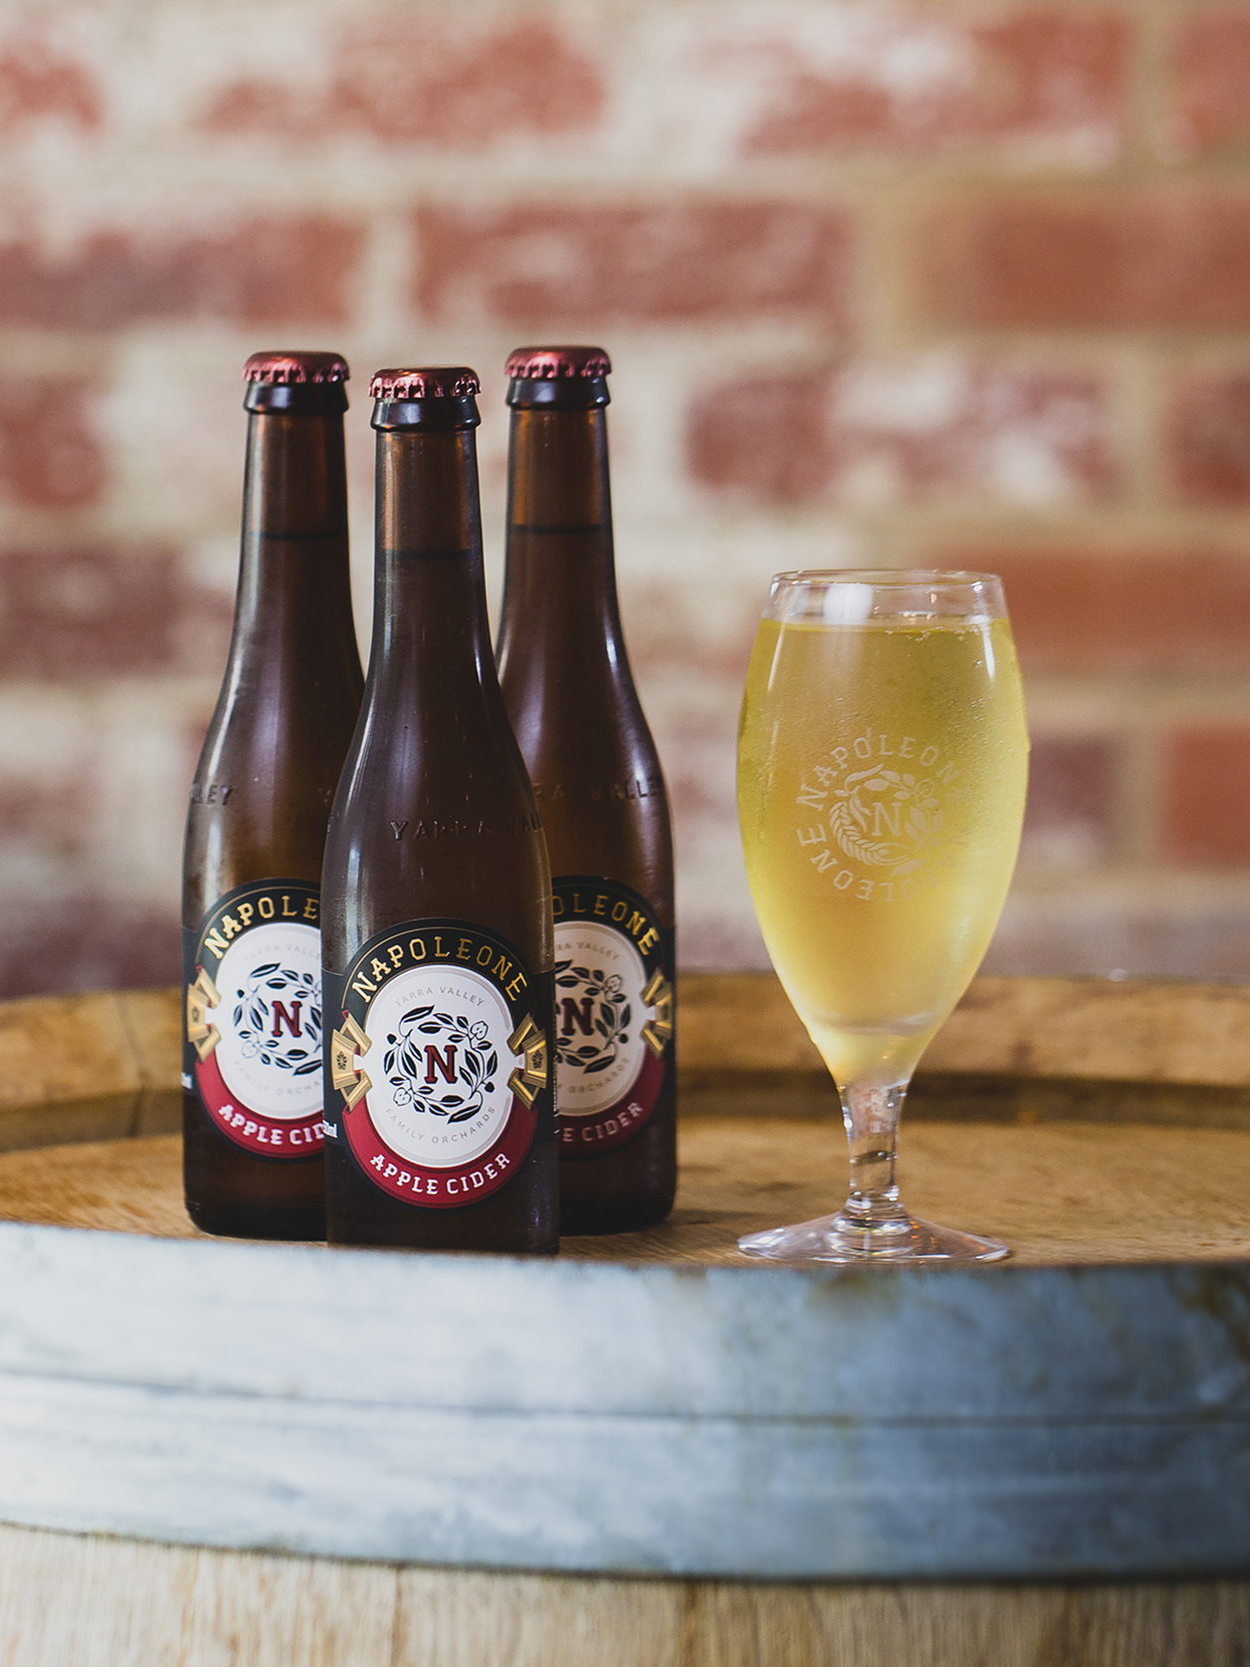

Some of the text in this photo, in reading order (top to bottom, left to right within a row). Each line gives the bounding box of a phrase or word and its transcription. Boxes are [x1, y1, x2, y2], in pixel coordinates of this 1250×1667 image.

[871, 801, 903, 837] N
[204, 895, 320, 960] NAPOLE
[352, 936, 528, 1004] NAPOLEONE
[394, 986, 485, 1008] YARRA VALLEY
[560, 997, 595, 1036] N
[271, 1000, 303, 1038] N
[423, 1045, 458, 1084] N
[218, 1104, 284, 1145] APPLE
[385, 1106, 496, 1144] FAMILY ORCHARDS
[581, 1102, 644, 1142] CIDER
[369, 1153, 511, 1195] APPLE CIDER
